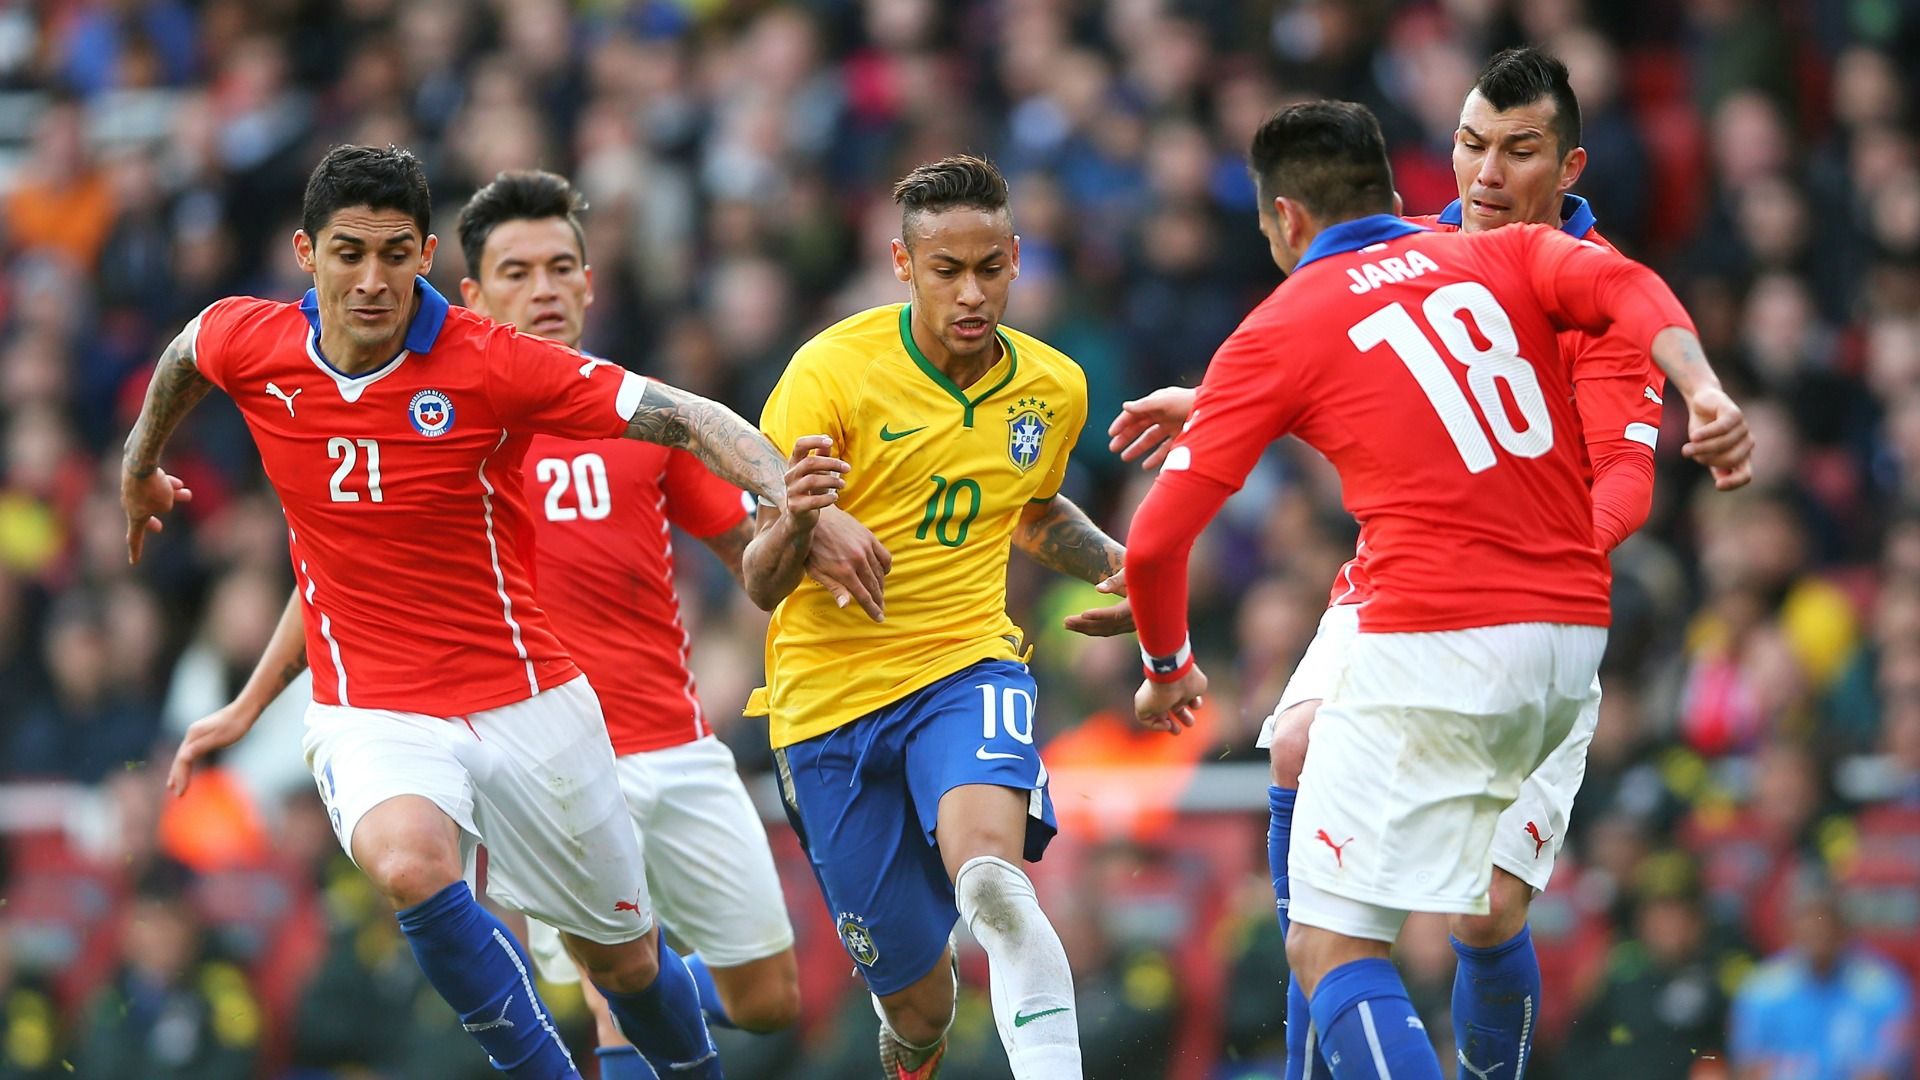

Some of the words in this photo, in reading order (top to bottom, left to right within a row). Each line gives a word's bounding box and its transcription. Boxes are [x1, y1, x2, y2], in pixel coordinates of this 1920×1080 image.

[1346, 250, 1439, 294] JARA
[1347, 281, 1554, 474] 18
[327, 436, 383, 502] 21
[1021, 435, 1035, 443] CBF
[536, 452, 611, 521] 20
[916, 475, 981, 547] 10
[975, 684, 1034, 745] 10
